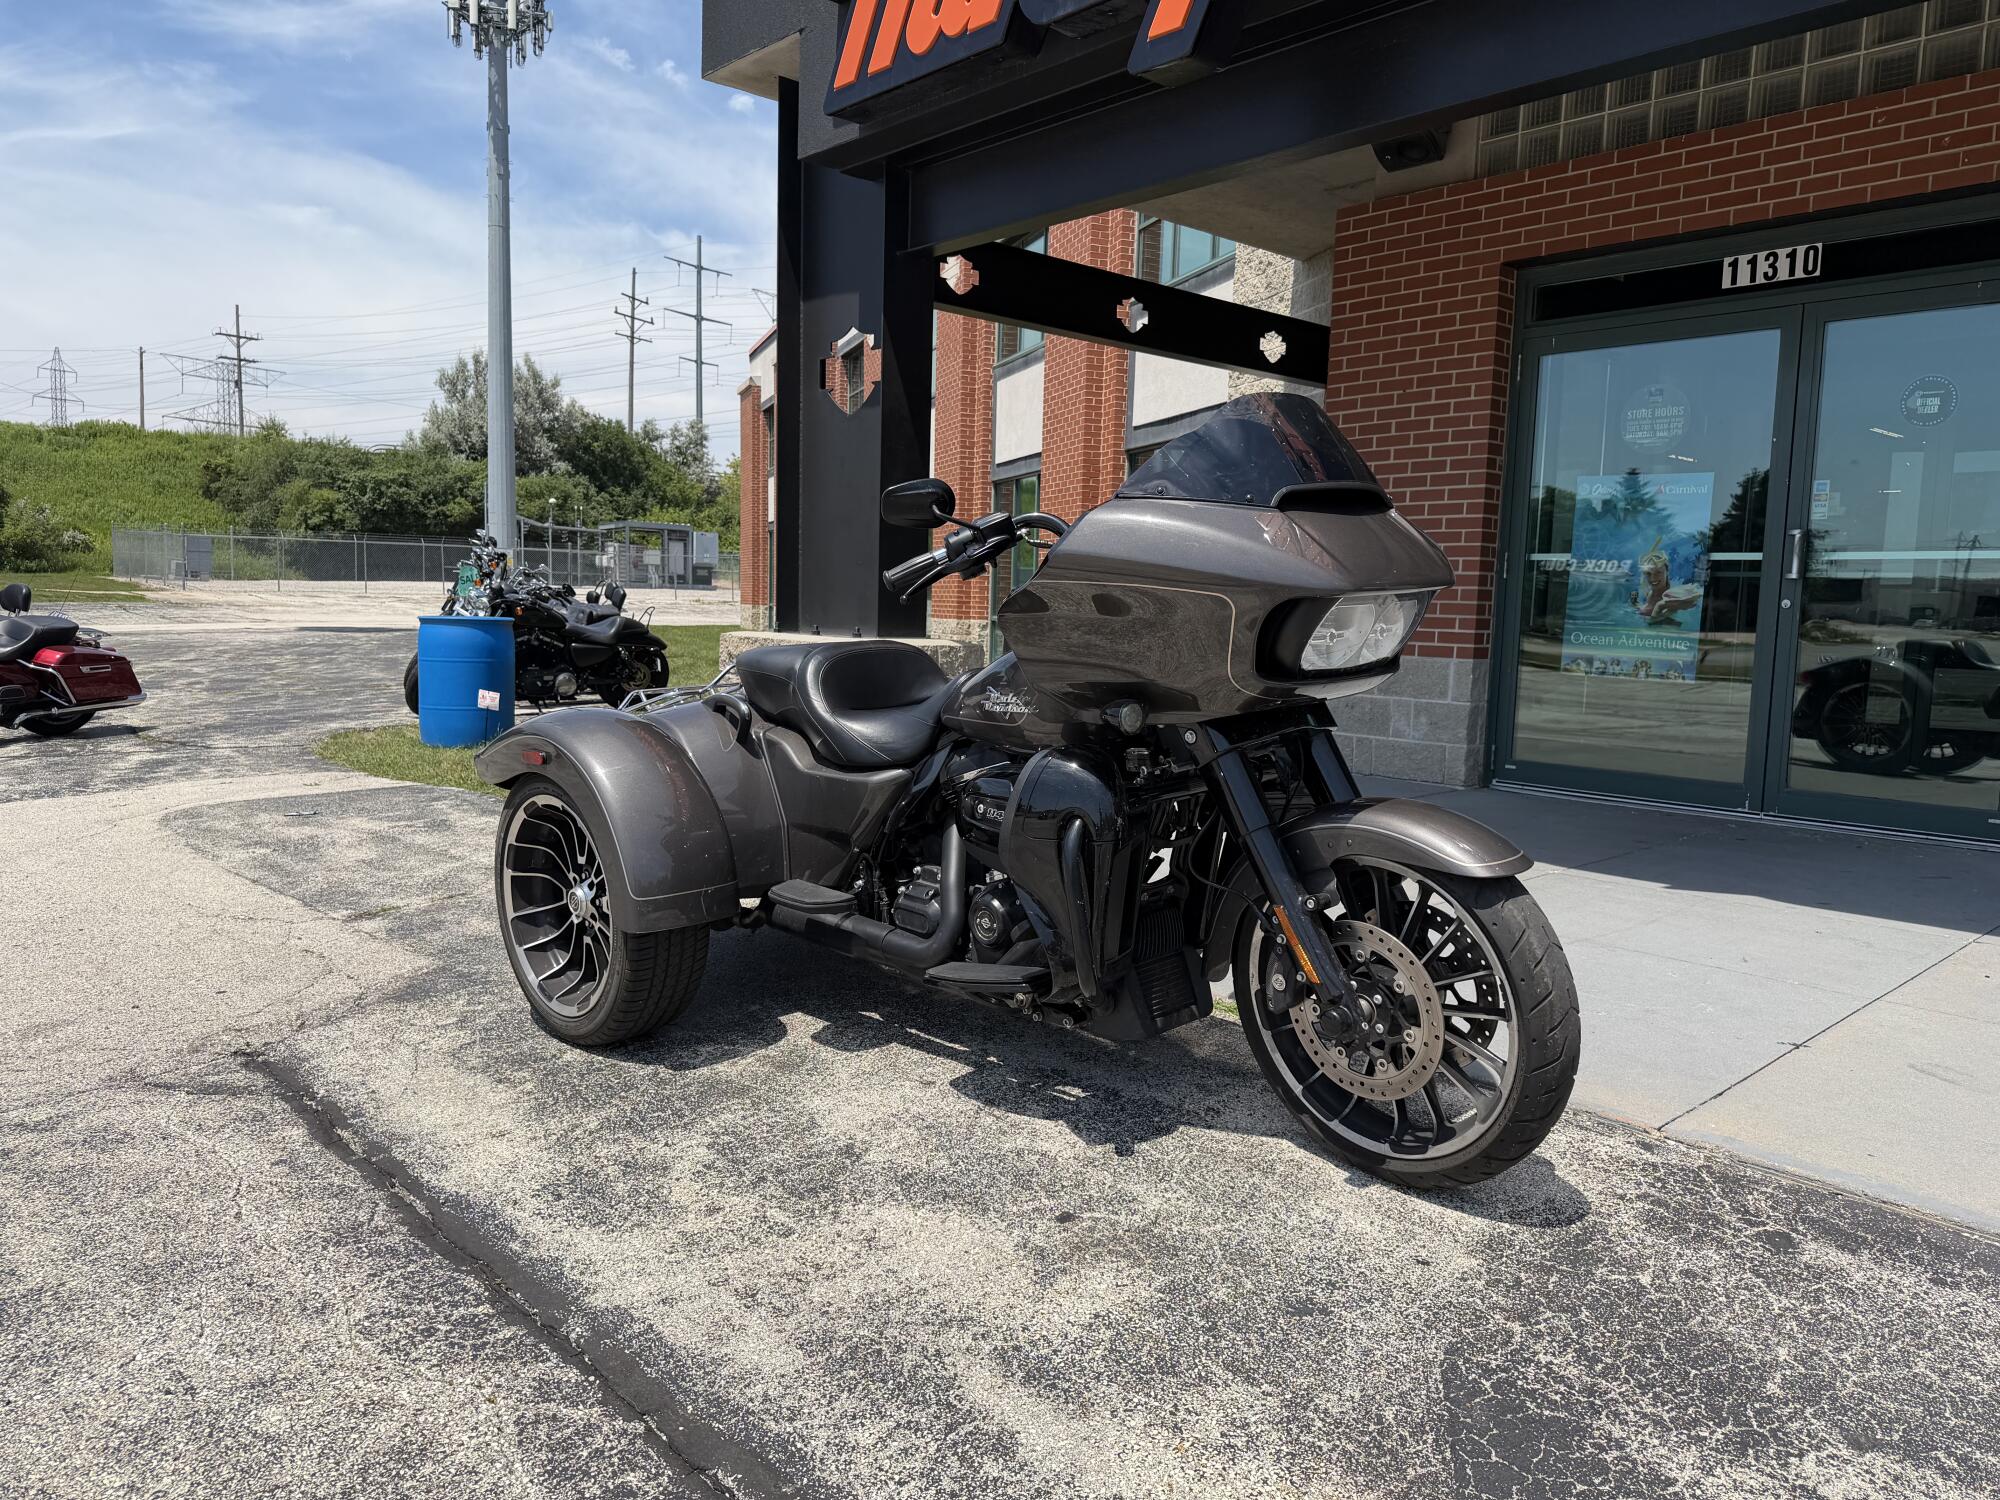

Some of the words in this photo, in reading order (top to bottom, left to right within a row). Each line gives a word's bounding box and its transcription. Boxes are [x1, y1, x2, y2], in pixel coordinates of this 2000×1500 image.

[1728, 245, 1820, 286] 11310
[1627, 408, 1653, 419] STORE
[1655, 406, 1685, 417] HOURS
[1665, 484, 1708, 495] Carnival
[1571, 631, 1613, 646] Ocean
[1620, 634, 1690, 650] Adventure
